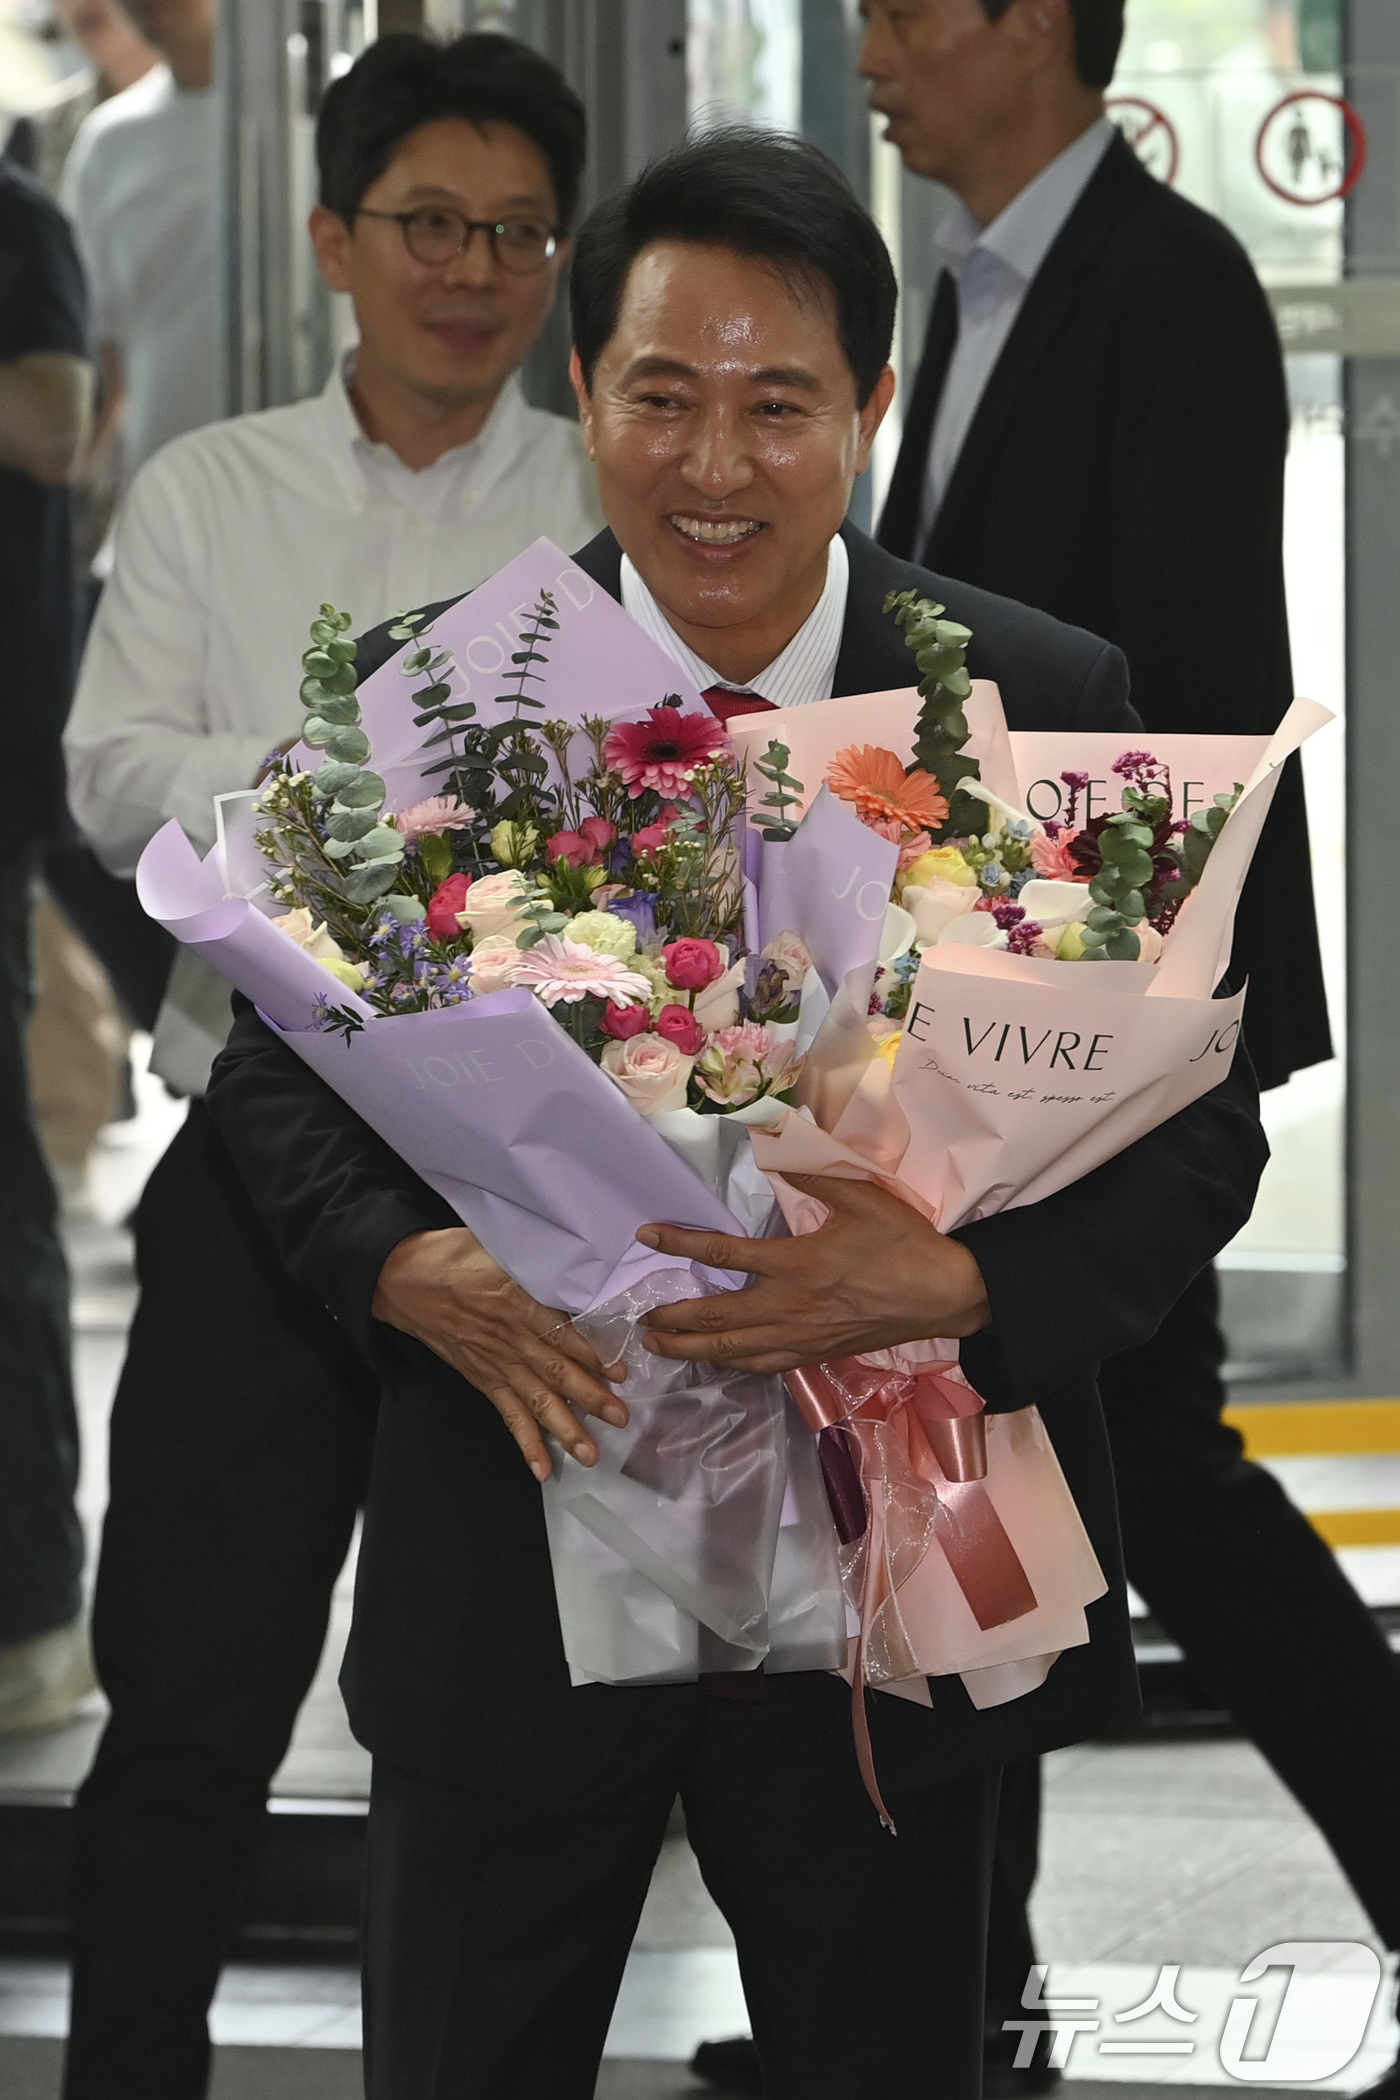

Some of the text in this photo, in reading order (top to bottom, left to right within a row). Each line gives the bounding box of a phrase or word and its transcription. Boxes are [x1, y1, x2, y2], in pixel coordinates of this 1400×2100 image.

[831, 865, 891, 921] JO
[962, 1016, 1114, 1071] VIVRE
[1188, 1018, 1240, 1063] JO
[403, 1049, 504, 1090] JOIE
